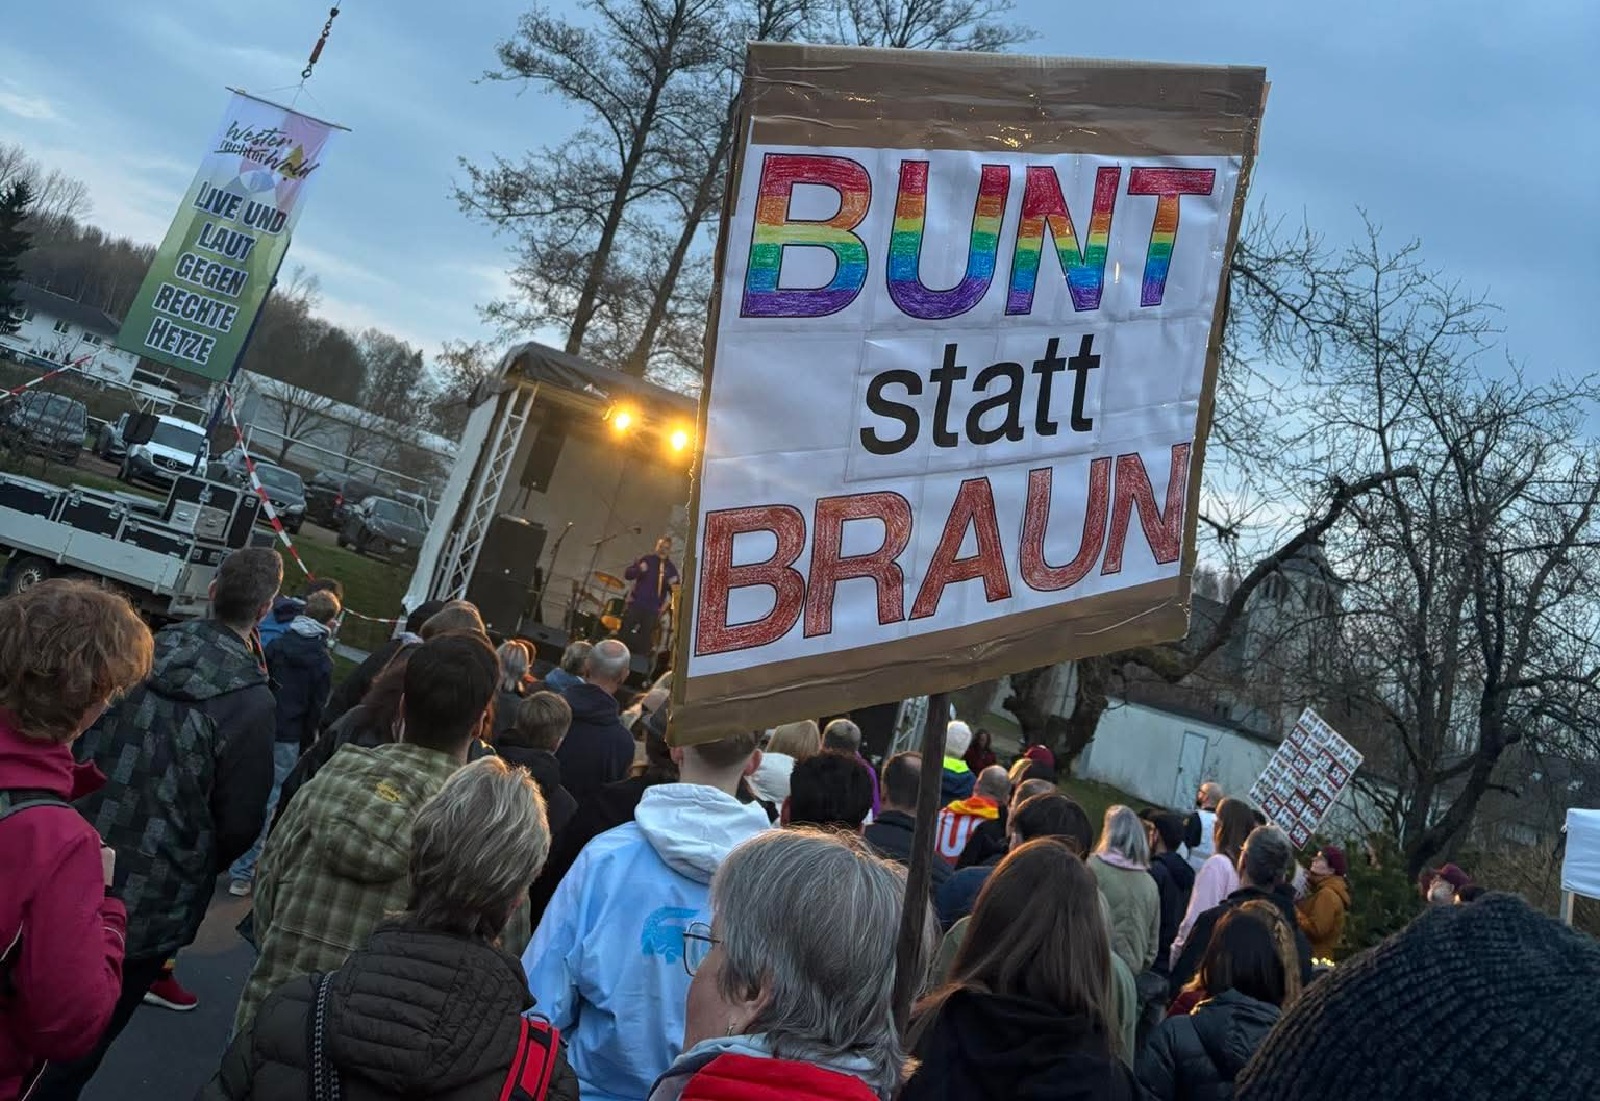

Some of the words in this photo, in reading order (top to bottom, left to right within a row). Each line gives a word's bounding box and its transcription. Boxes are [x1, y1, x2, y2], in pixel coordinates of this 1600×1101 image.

[194, 182, 243, 220] LIVE
[244, 201, 287, 235] UND
[199, 223, 255, 260] LAUT
[739, 152, 1216, 319] BUNT
[175, 253, 247, 297] GEGEN
[153, 284, 237, 331] RECHTE
[145, 318, 215, 364] HETZE
[860, 334, 1101, 455] statt
[693, 443, 1192, 657] BRAUN
